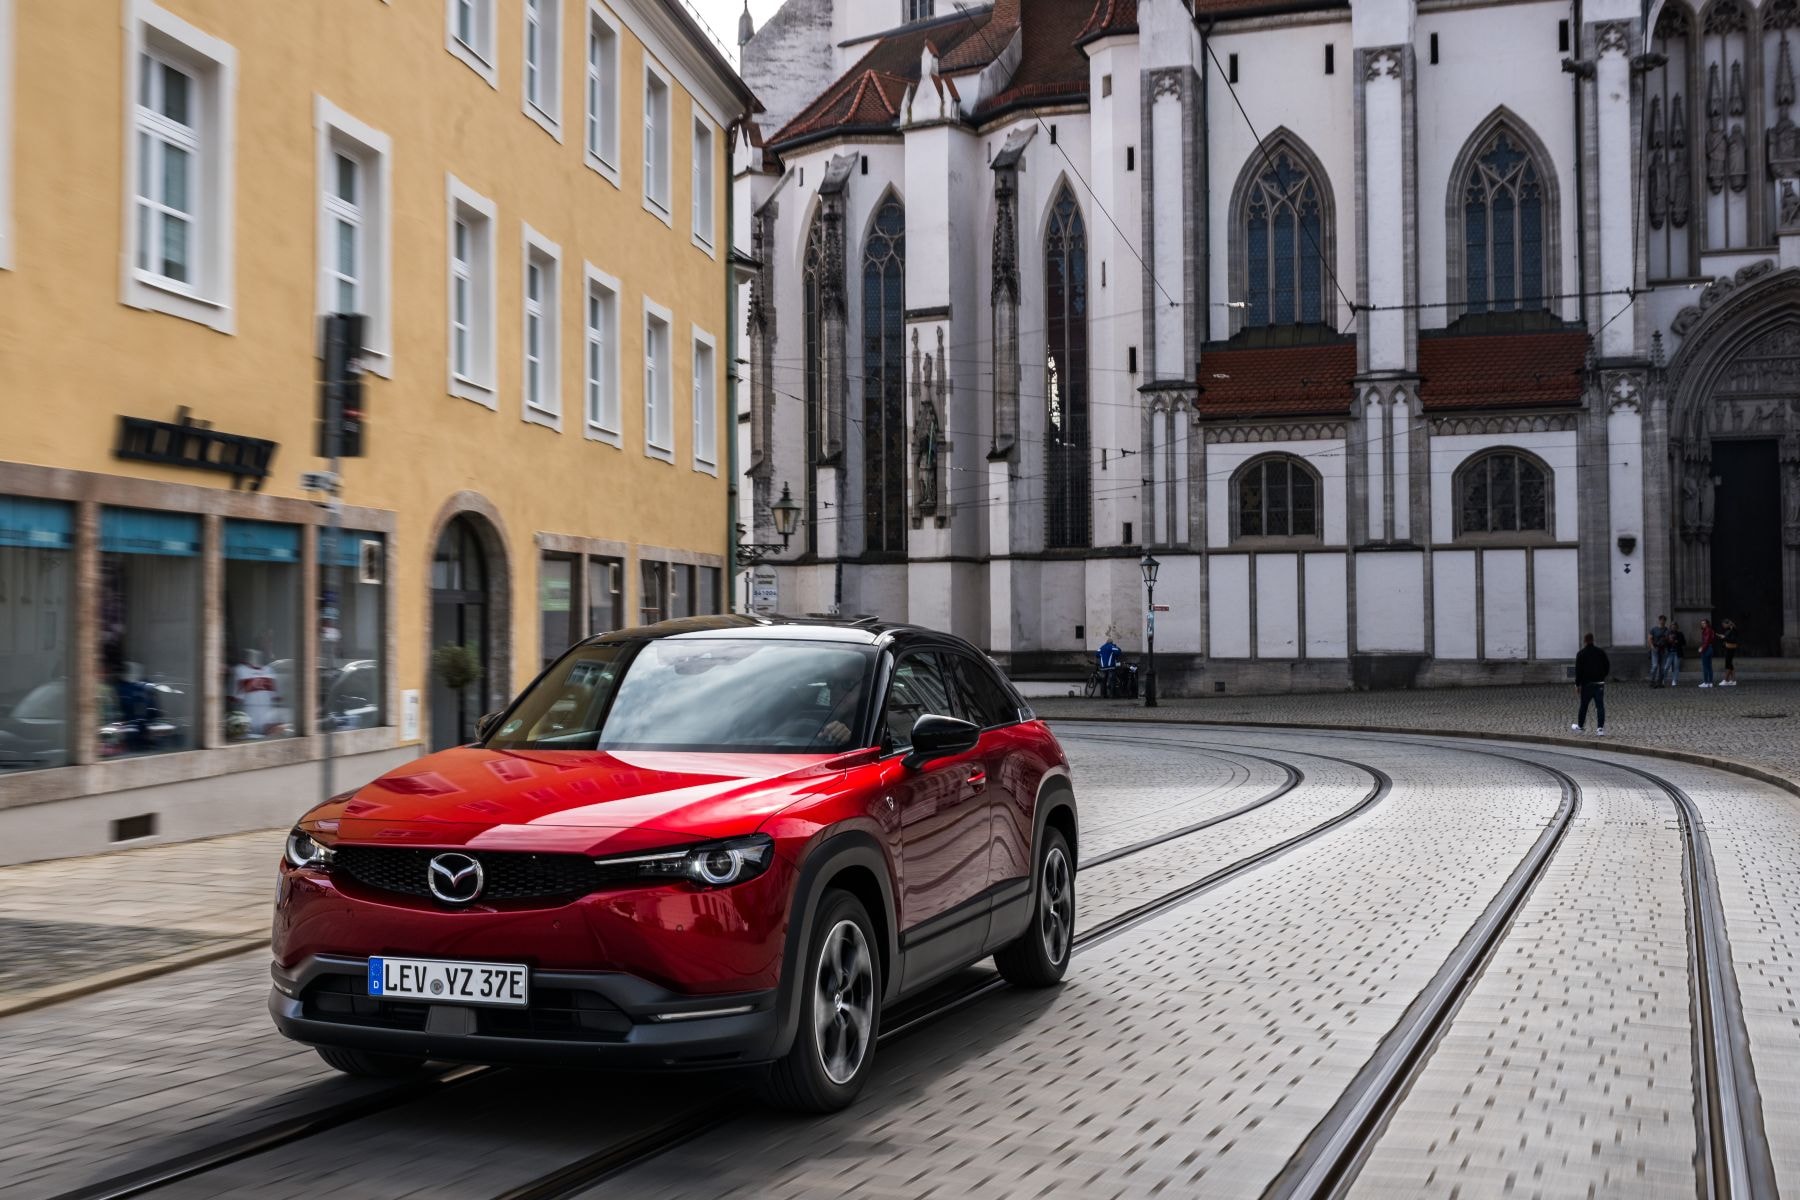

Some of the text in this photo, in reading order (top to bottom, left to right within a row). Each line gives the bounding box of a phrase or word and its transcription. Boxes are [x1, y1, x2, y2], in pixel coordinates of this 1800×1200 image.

[373, 980, 380, 989] D
[385, 964, 523, 999] LEV YZ 37E
